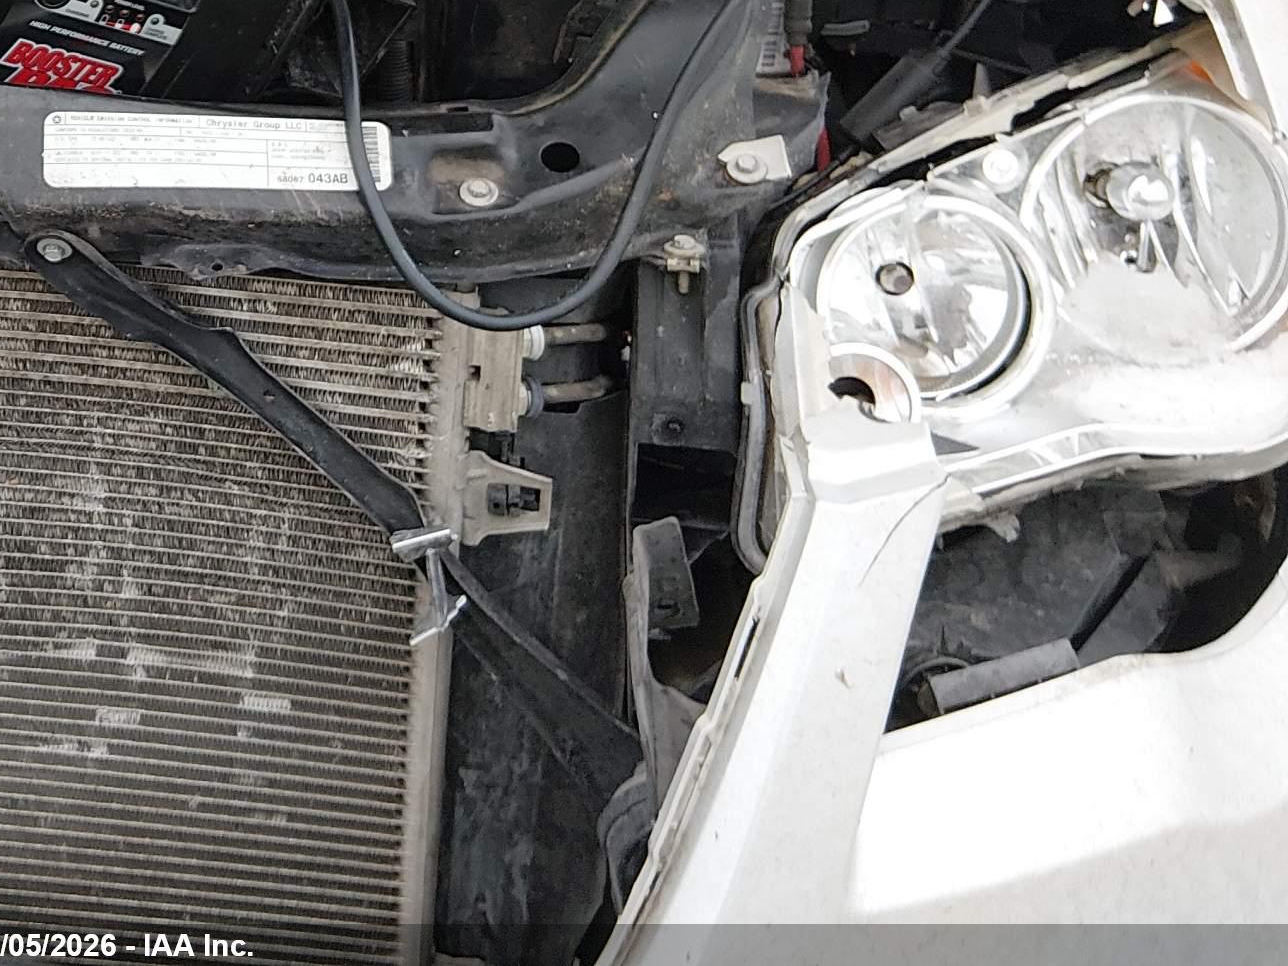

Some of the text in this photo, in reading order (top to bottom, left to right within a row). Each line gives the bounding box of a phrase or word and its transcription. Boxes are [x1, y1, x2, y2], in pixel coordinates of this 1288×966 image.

[29, 20, 144, 55] HIGH PERFORMANCE BATTERY
[0, 38, 123, 90] BOOSTER
[206, 119, 248, 130] Chrysler
[253, 120, 281, 130] Group
[285, 121, 302, 130] LLC
[307, 172, 349, 184] 043AB
